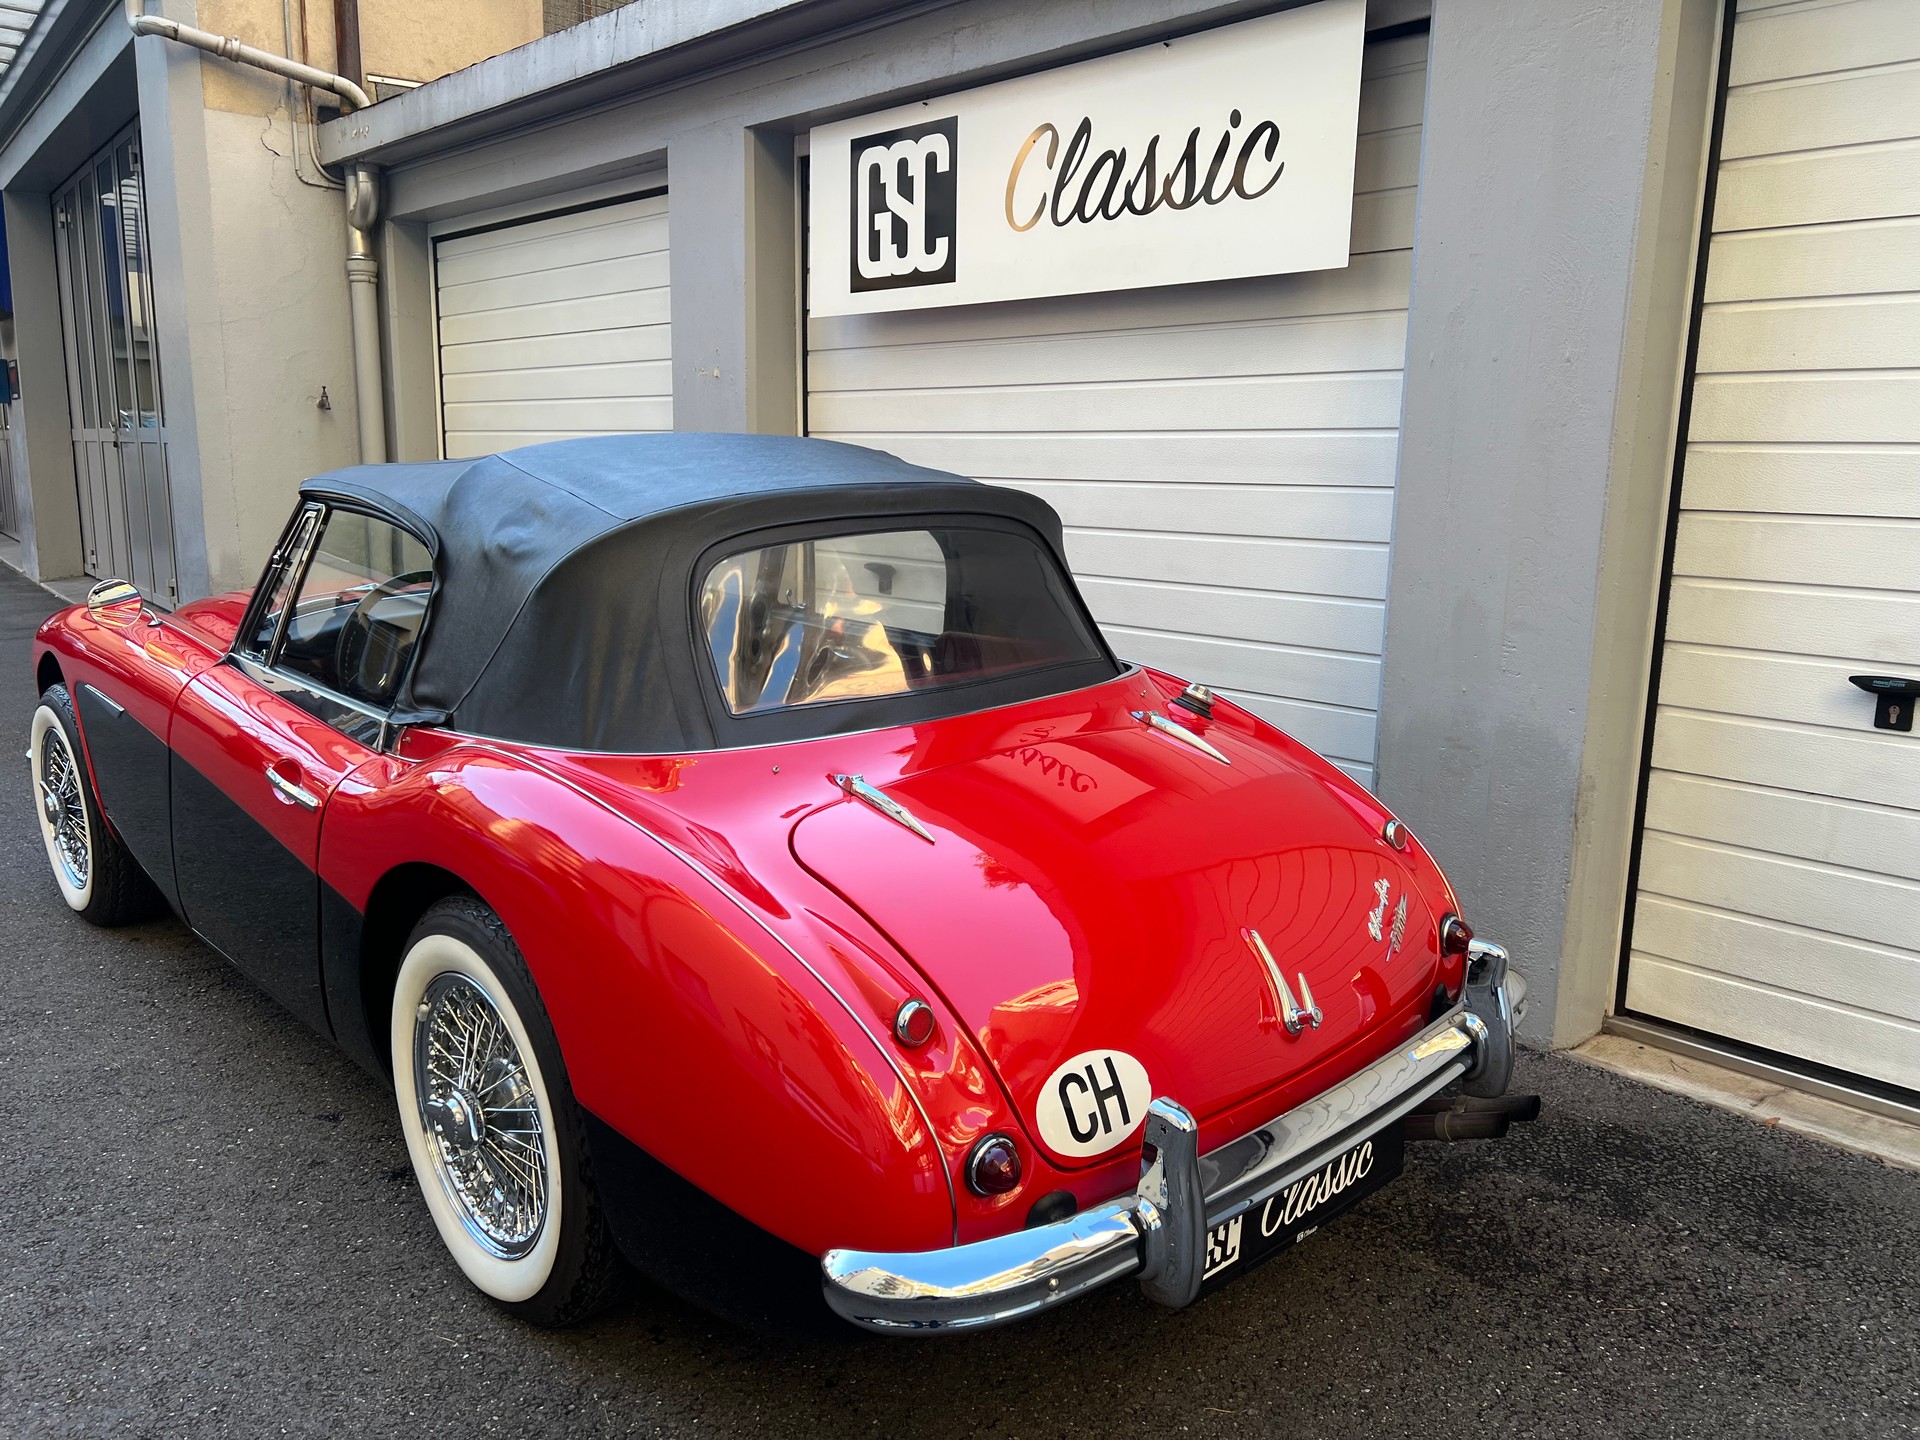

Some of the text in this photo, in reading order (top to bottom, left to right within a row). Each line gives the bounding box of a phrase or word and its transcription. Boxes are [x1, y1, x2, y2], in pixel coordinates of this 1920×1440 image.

[858, 109, 1285, 279] GSC Classic
[1058, 1056, 1131, 1144] CH
[1261, 1141, 1373, 1237] Classic
